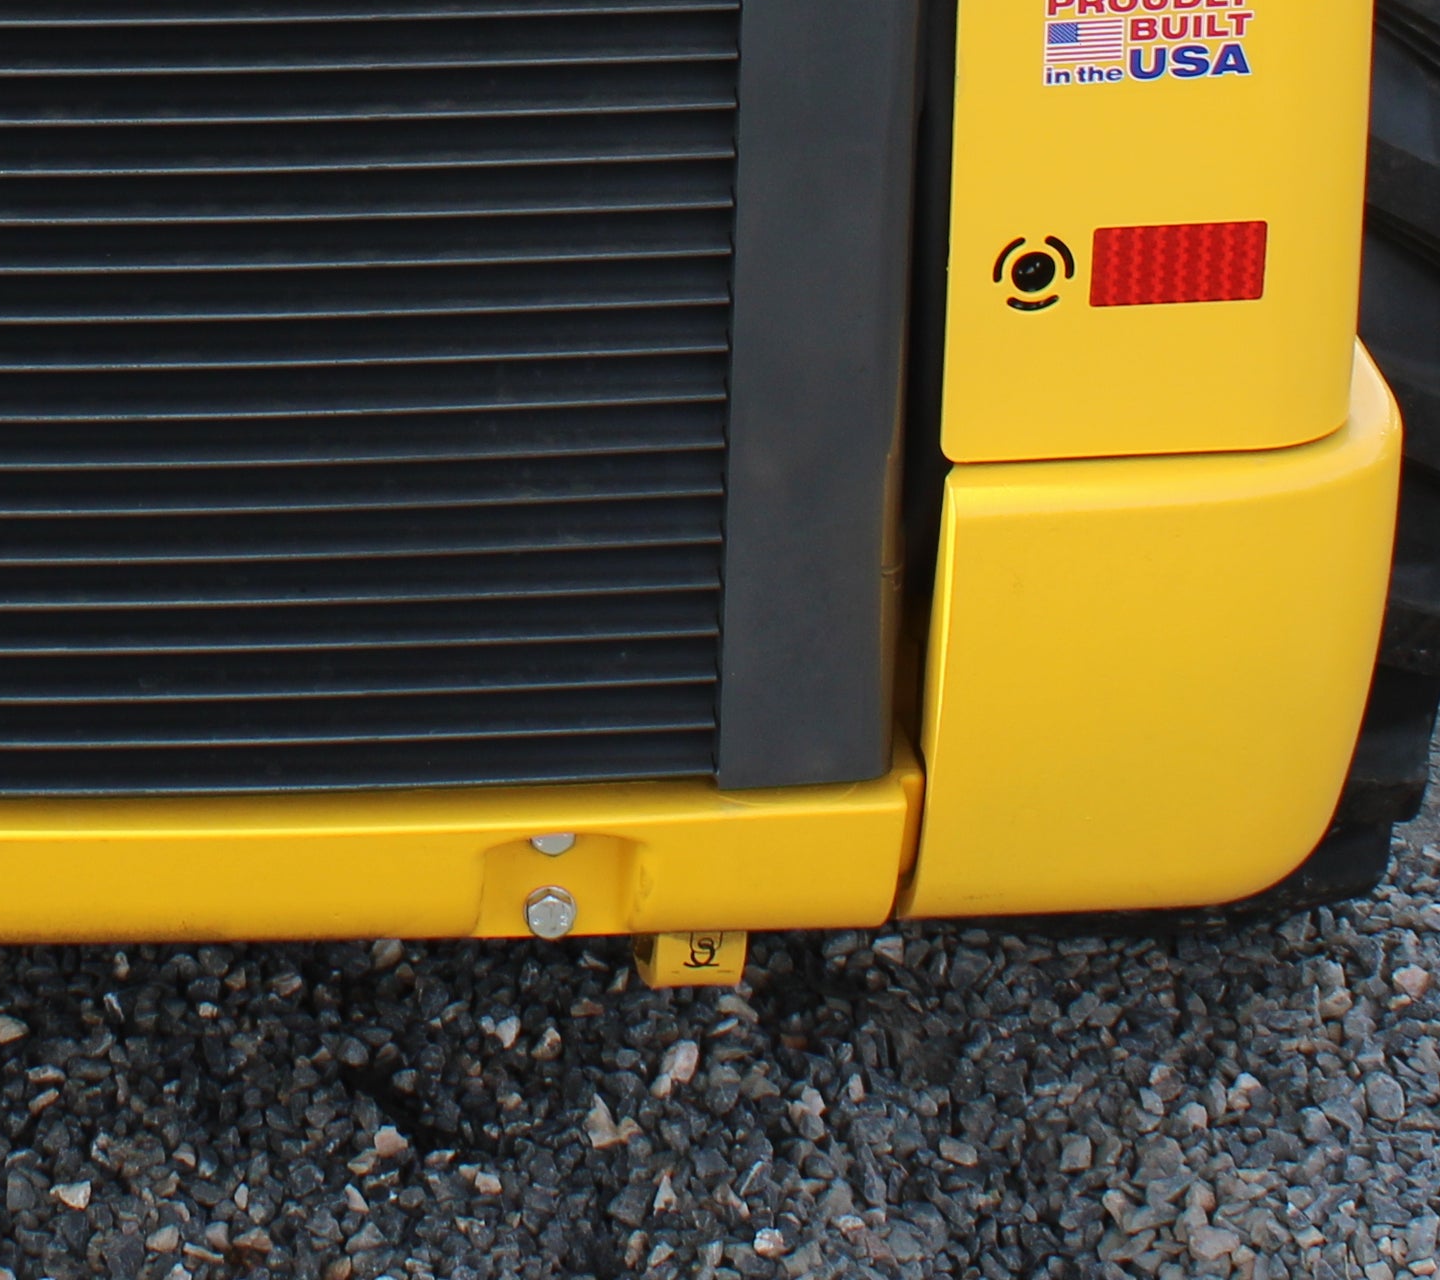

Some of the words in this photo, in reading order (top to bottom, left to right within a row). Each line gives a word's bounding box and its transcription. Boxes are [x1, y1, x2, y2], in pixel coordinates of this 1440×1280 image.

[1129, 12, 1254, 42] BUILT
[1046, 67, 1071, 85] in
[1077, 65, 1123, 83] the
[1128, 42, 1251, 80] USA
